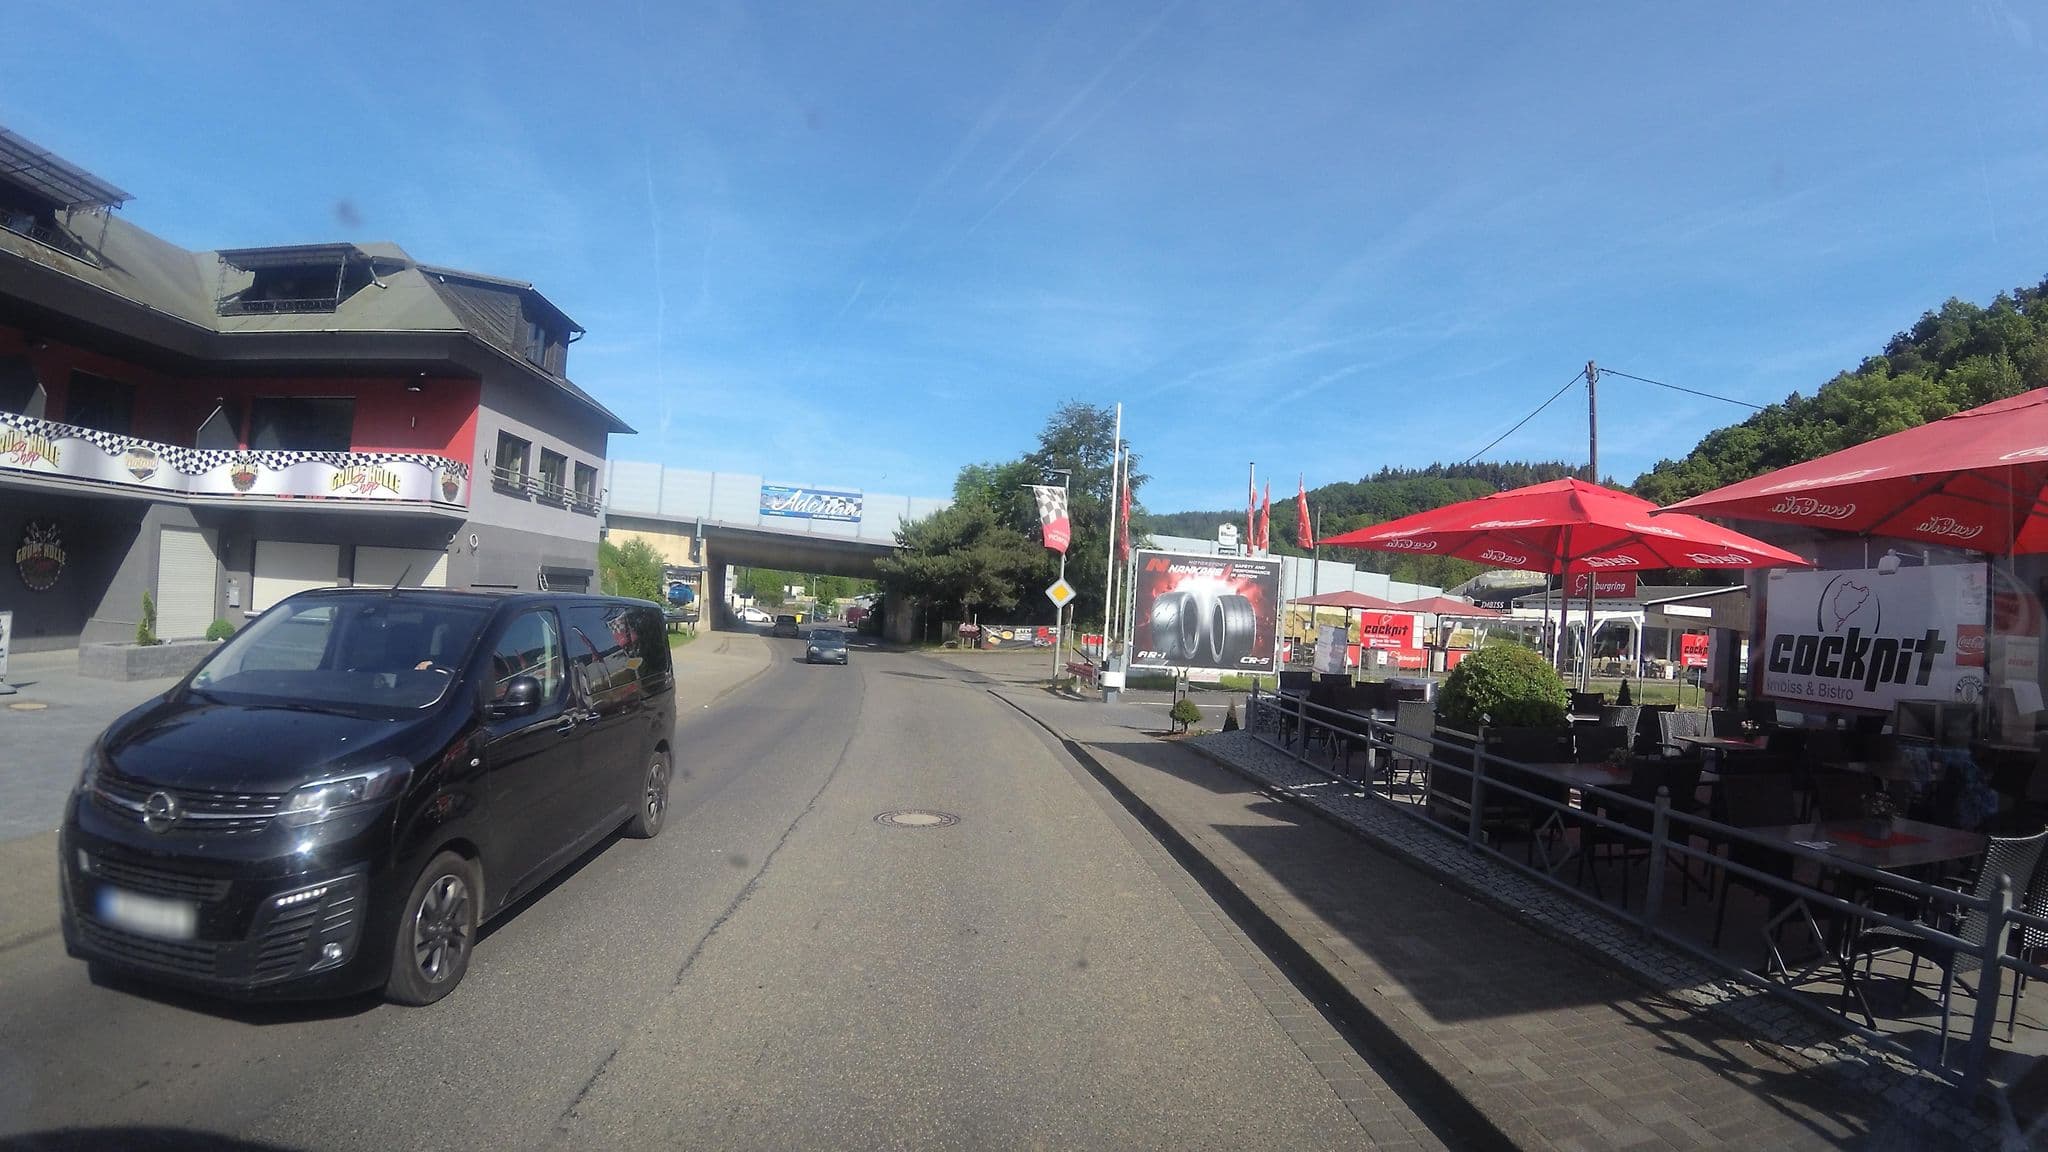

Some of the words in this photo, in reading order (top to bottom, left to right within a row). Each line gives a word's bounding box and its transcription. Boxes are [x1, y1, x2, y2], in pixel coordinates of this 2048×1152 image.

[350, 473, 381, 496] Shop
[1364, 623, 1409, 637] cockpit
[1768, 627, 1947, 693] cockpit
[1806, 682, 1815, 697] &
[1818, 682, 1854, 701] Bistro
